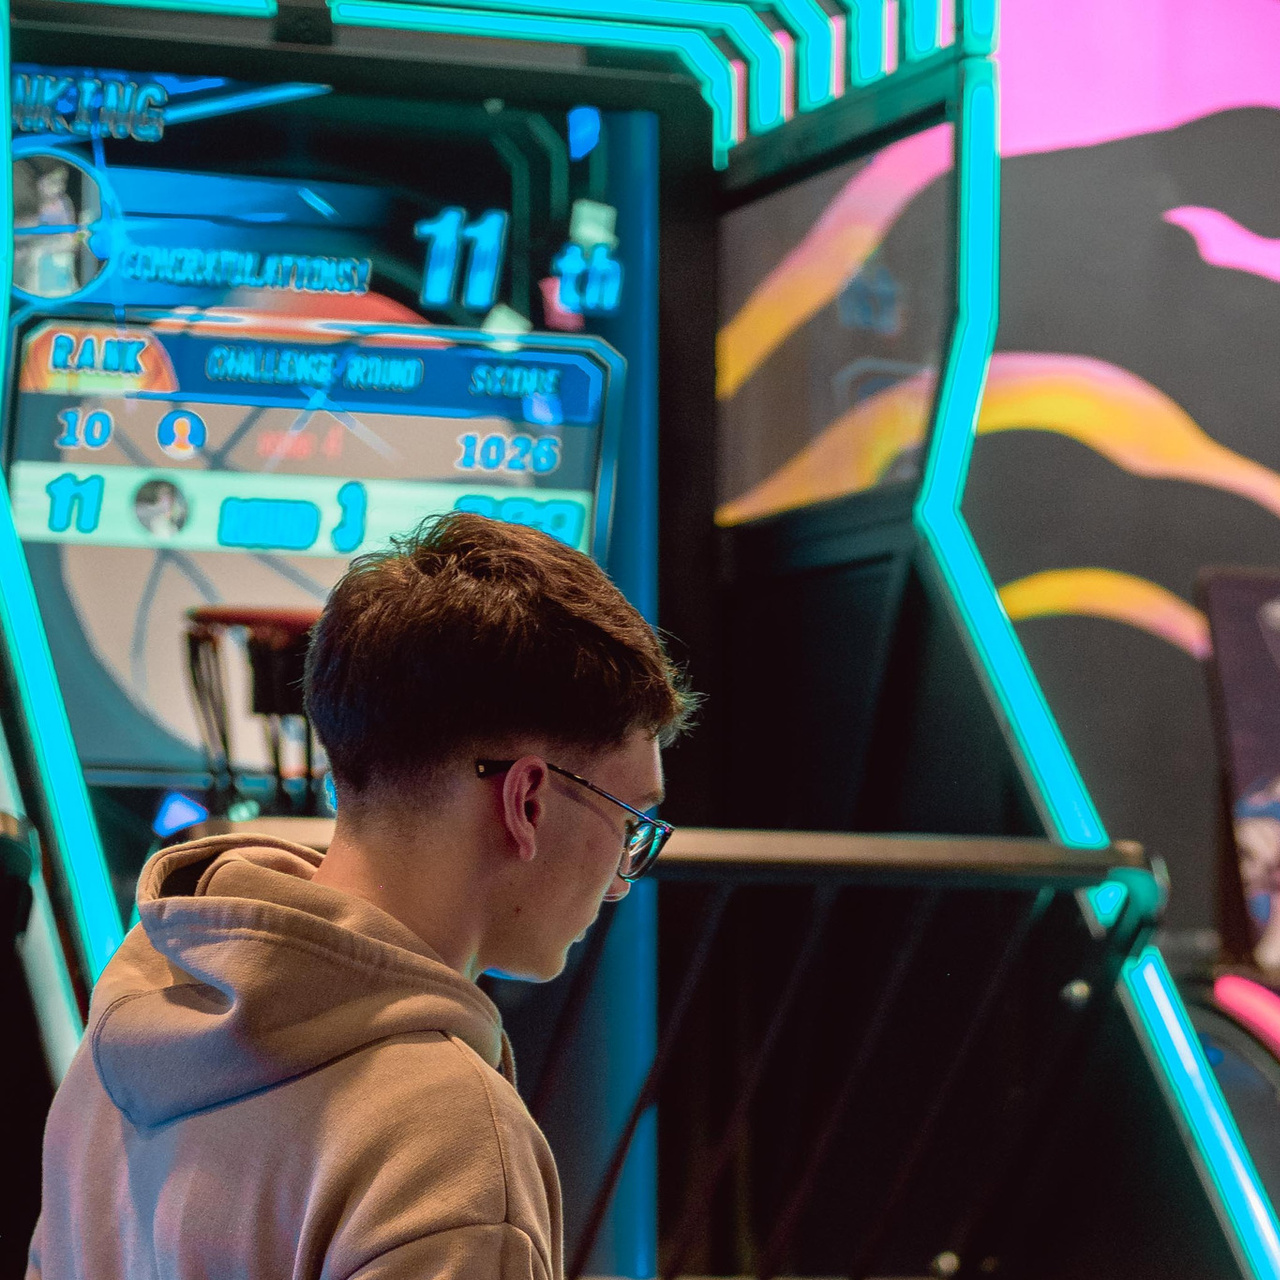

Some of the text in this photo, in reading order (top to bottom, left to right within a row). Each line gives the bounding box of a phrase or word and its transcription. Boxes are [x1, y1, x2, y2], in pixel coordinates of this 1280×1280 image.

[415, 206, 509, 310] 11
[51, 334, 148, 375] RANK
[55, 407, 114, 449] 10
[455, 431, 562, 474] 1026
